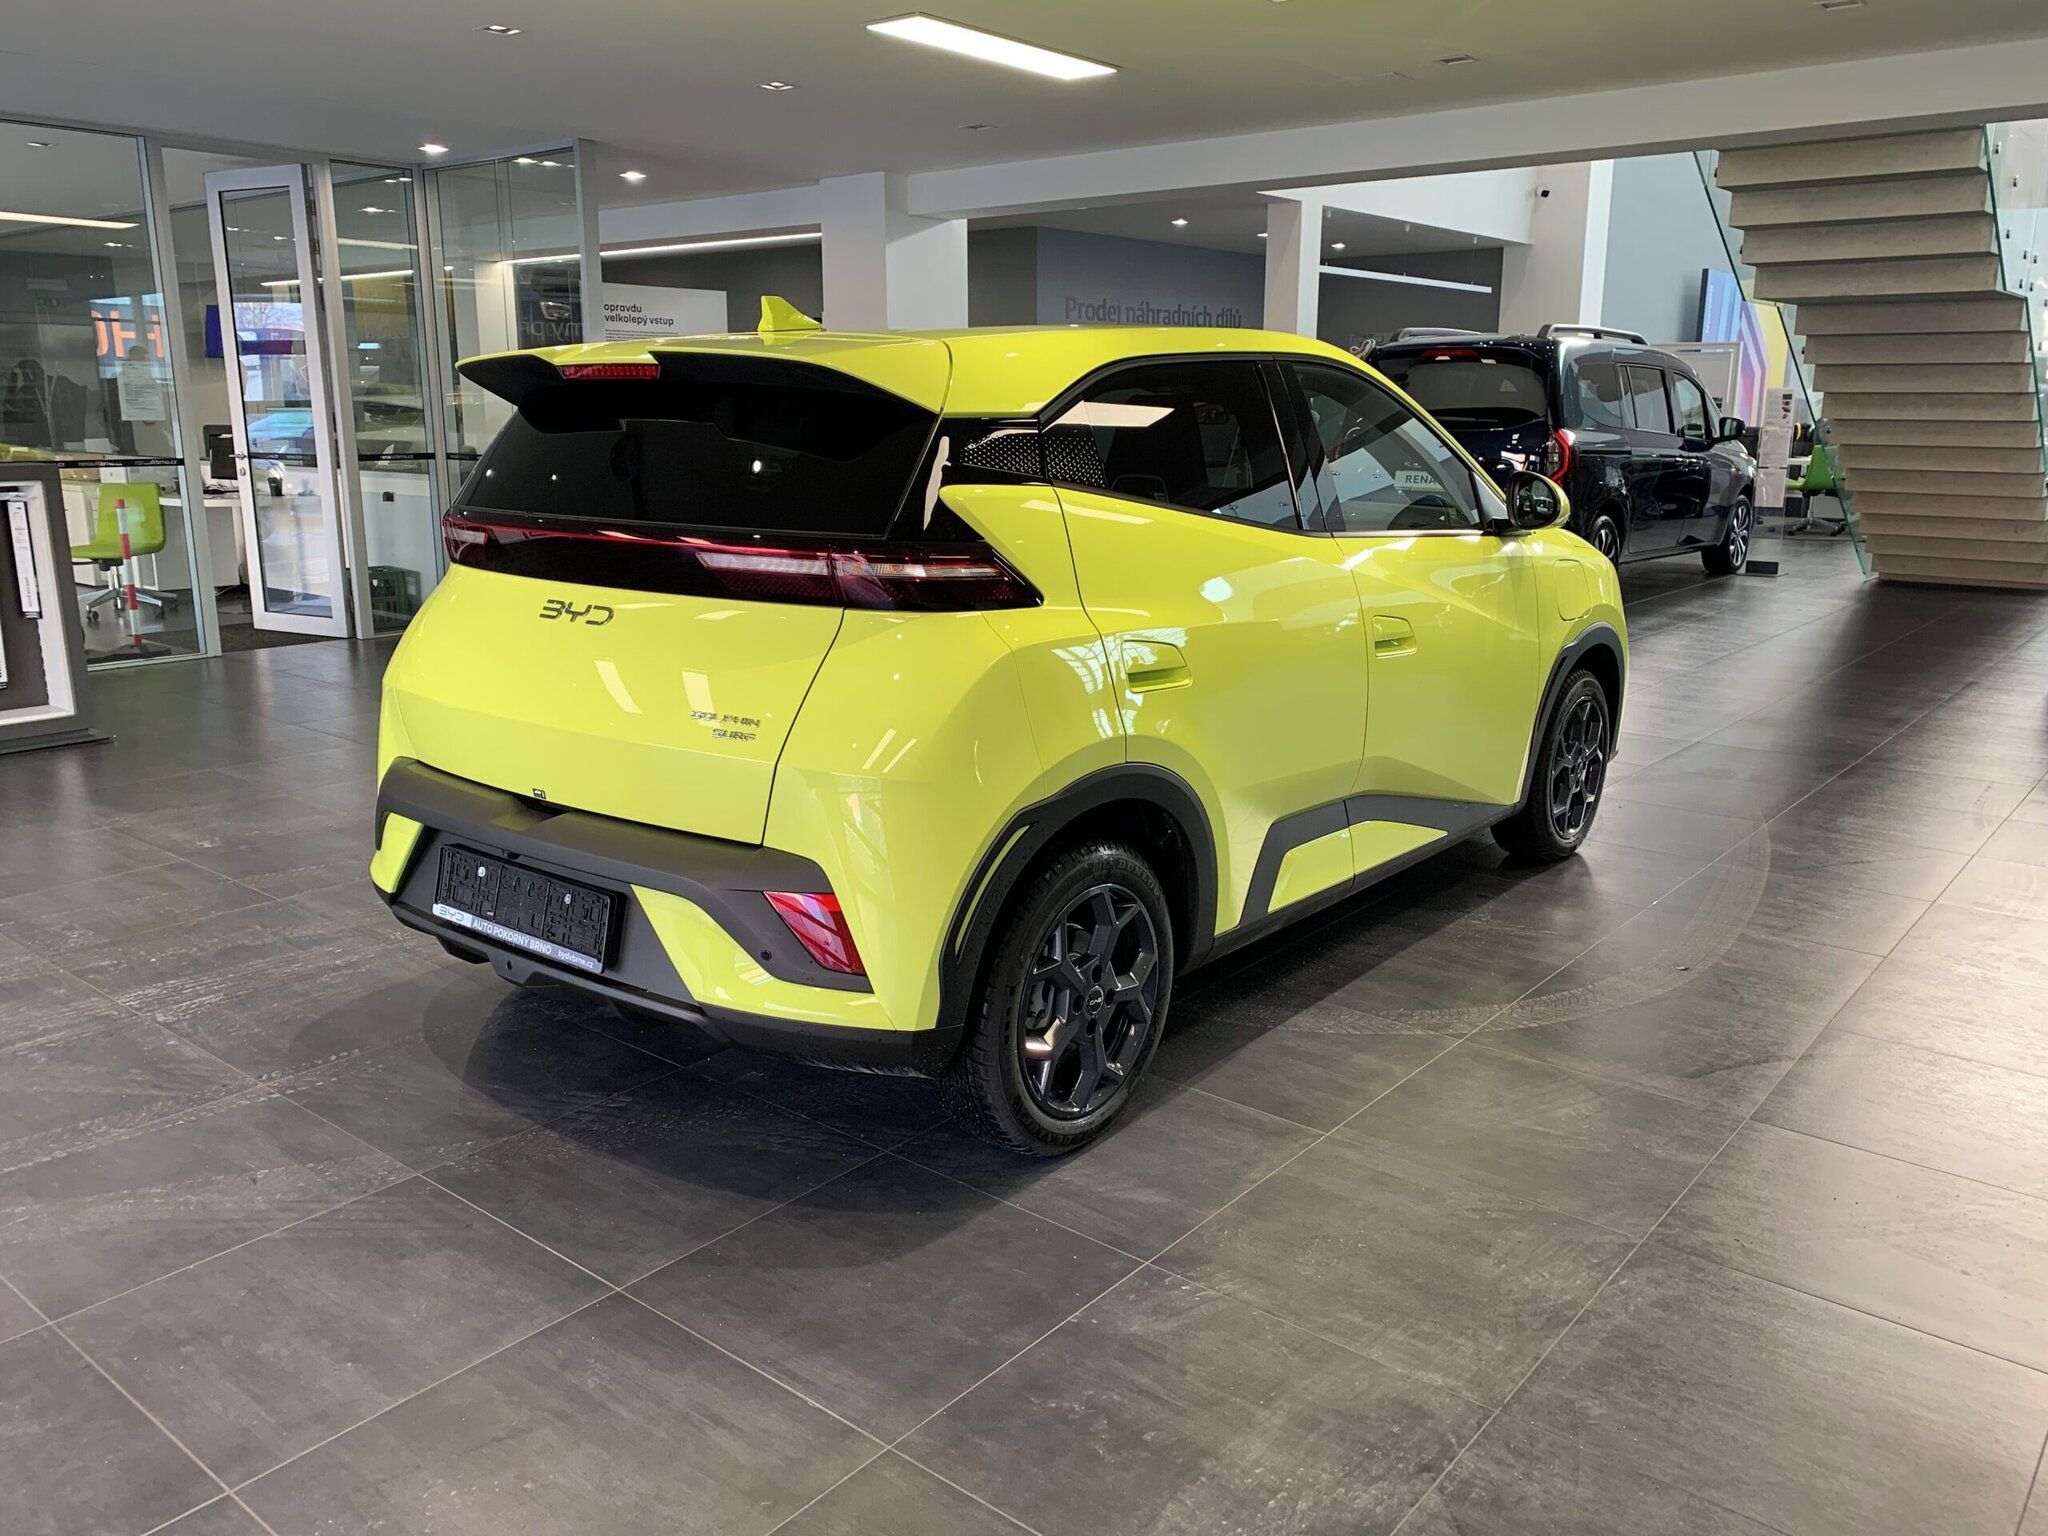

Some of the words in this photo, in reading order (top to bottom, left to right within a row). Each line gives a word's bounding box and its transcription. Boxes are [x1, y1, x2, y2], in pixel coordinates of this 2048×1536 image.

[603, 303, 642, 313] opravdu
[1064, 295, 1121, 325] Prodej
[1125, 300, 1212, 327] náhradních
[604, 314, 648, 326] velkolepý
[649, 316, 674, 327] vstup
[539, 599, 615, 626] BYD
[690, 710, 761, 728] DOLPHIN
[712, 728, 757, 742] SURF
[439, 906, 464, 922] BYD
[473, 919, 493, 934] AUTO
[493, 925, 529, 947] POKORNÝ
[530, 940, 551, 954] BRNO
